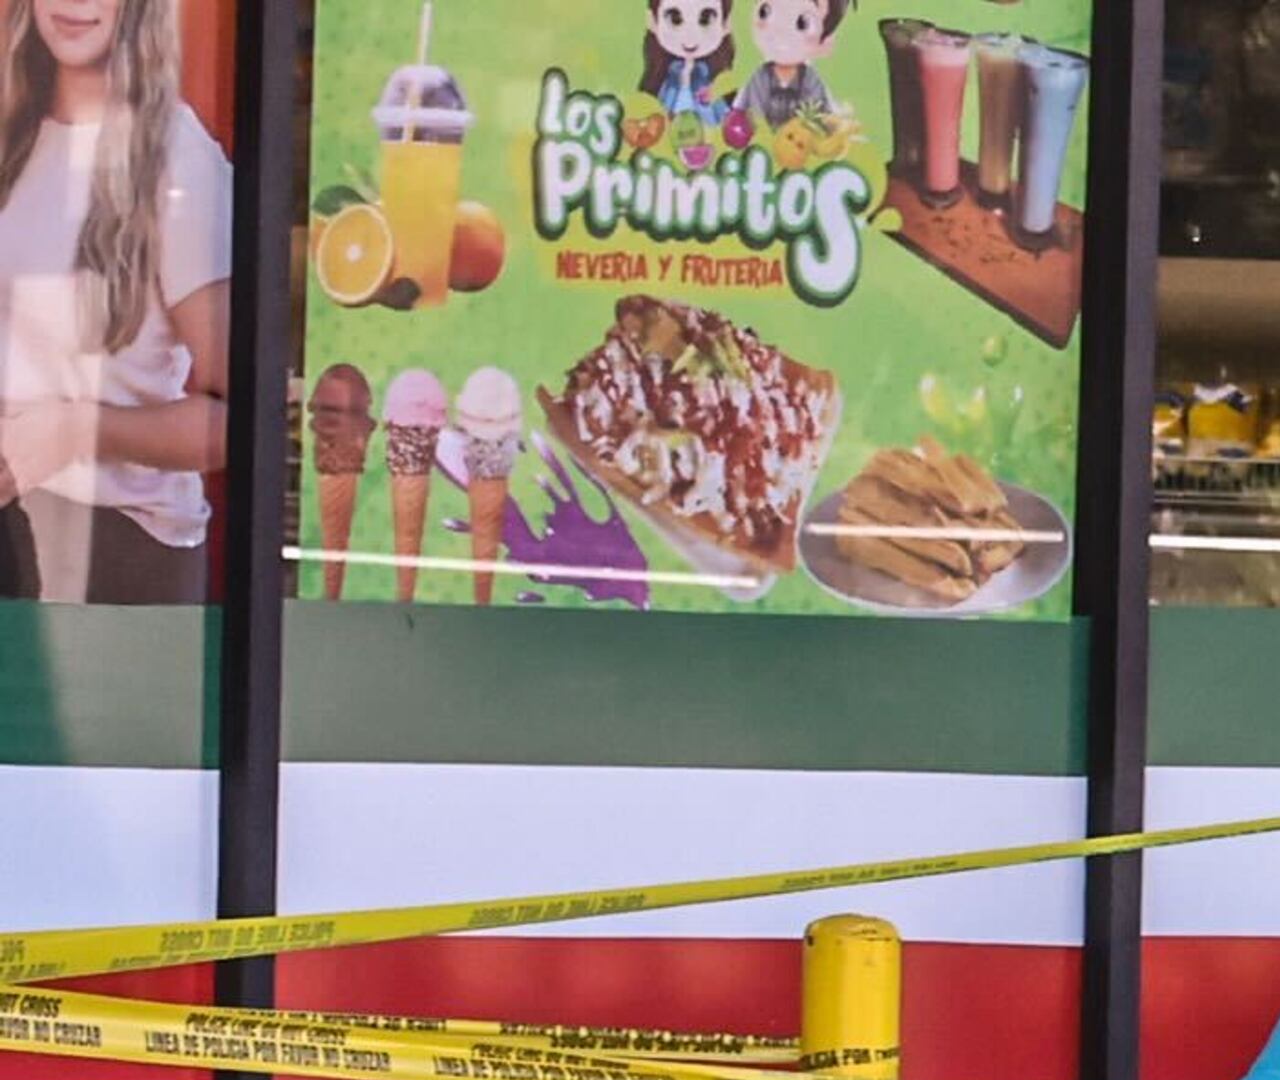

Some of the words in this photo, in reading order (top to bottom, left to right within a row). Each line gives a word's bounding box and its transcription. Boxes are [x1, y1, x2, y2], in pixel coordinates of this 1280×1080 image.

[537, 136, 870, 302] Primitos
[556, 251, 648, 282] NEVERIA
[659, 255, 673, 281] Y
[680, 254, 784, 288] FRUTERIA
[19, 994, 63, 1018] CROSS
[54, 1021, 102, 1048] CRUZAR
[145, 1030, 180, 1055] LINEA
[183, 1033, 201, 1057] DE
[202, 1035, 250, 1060] POLICIA
